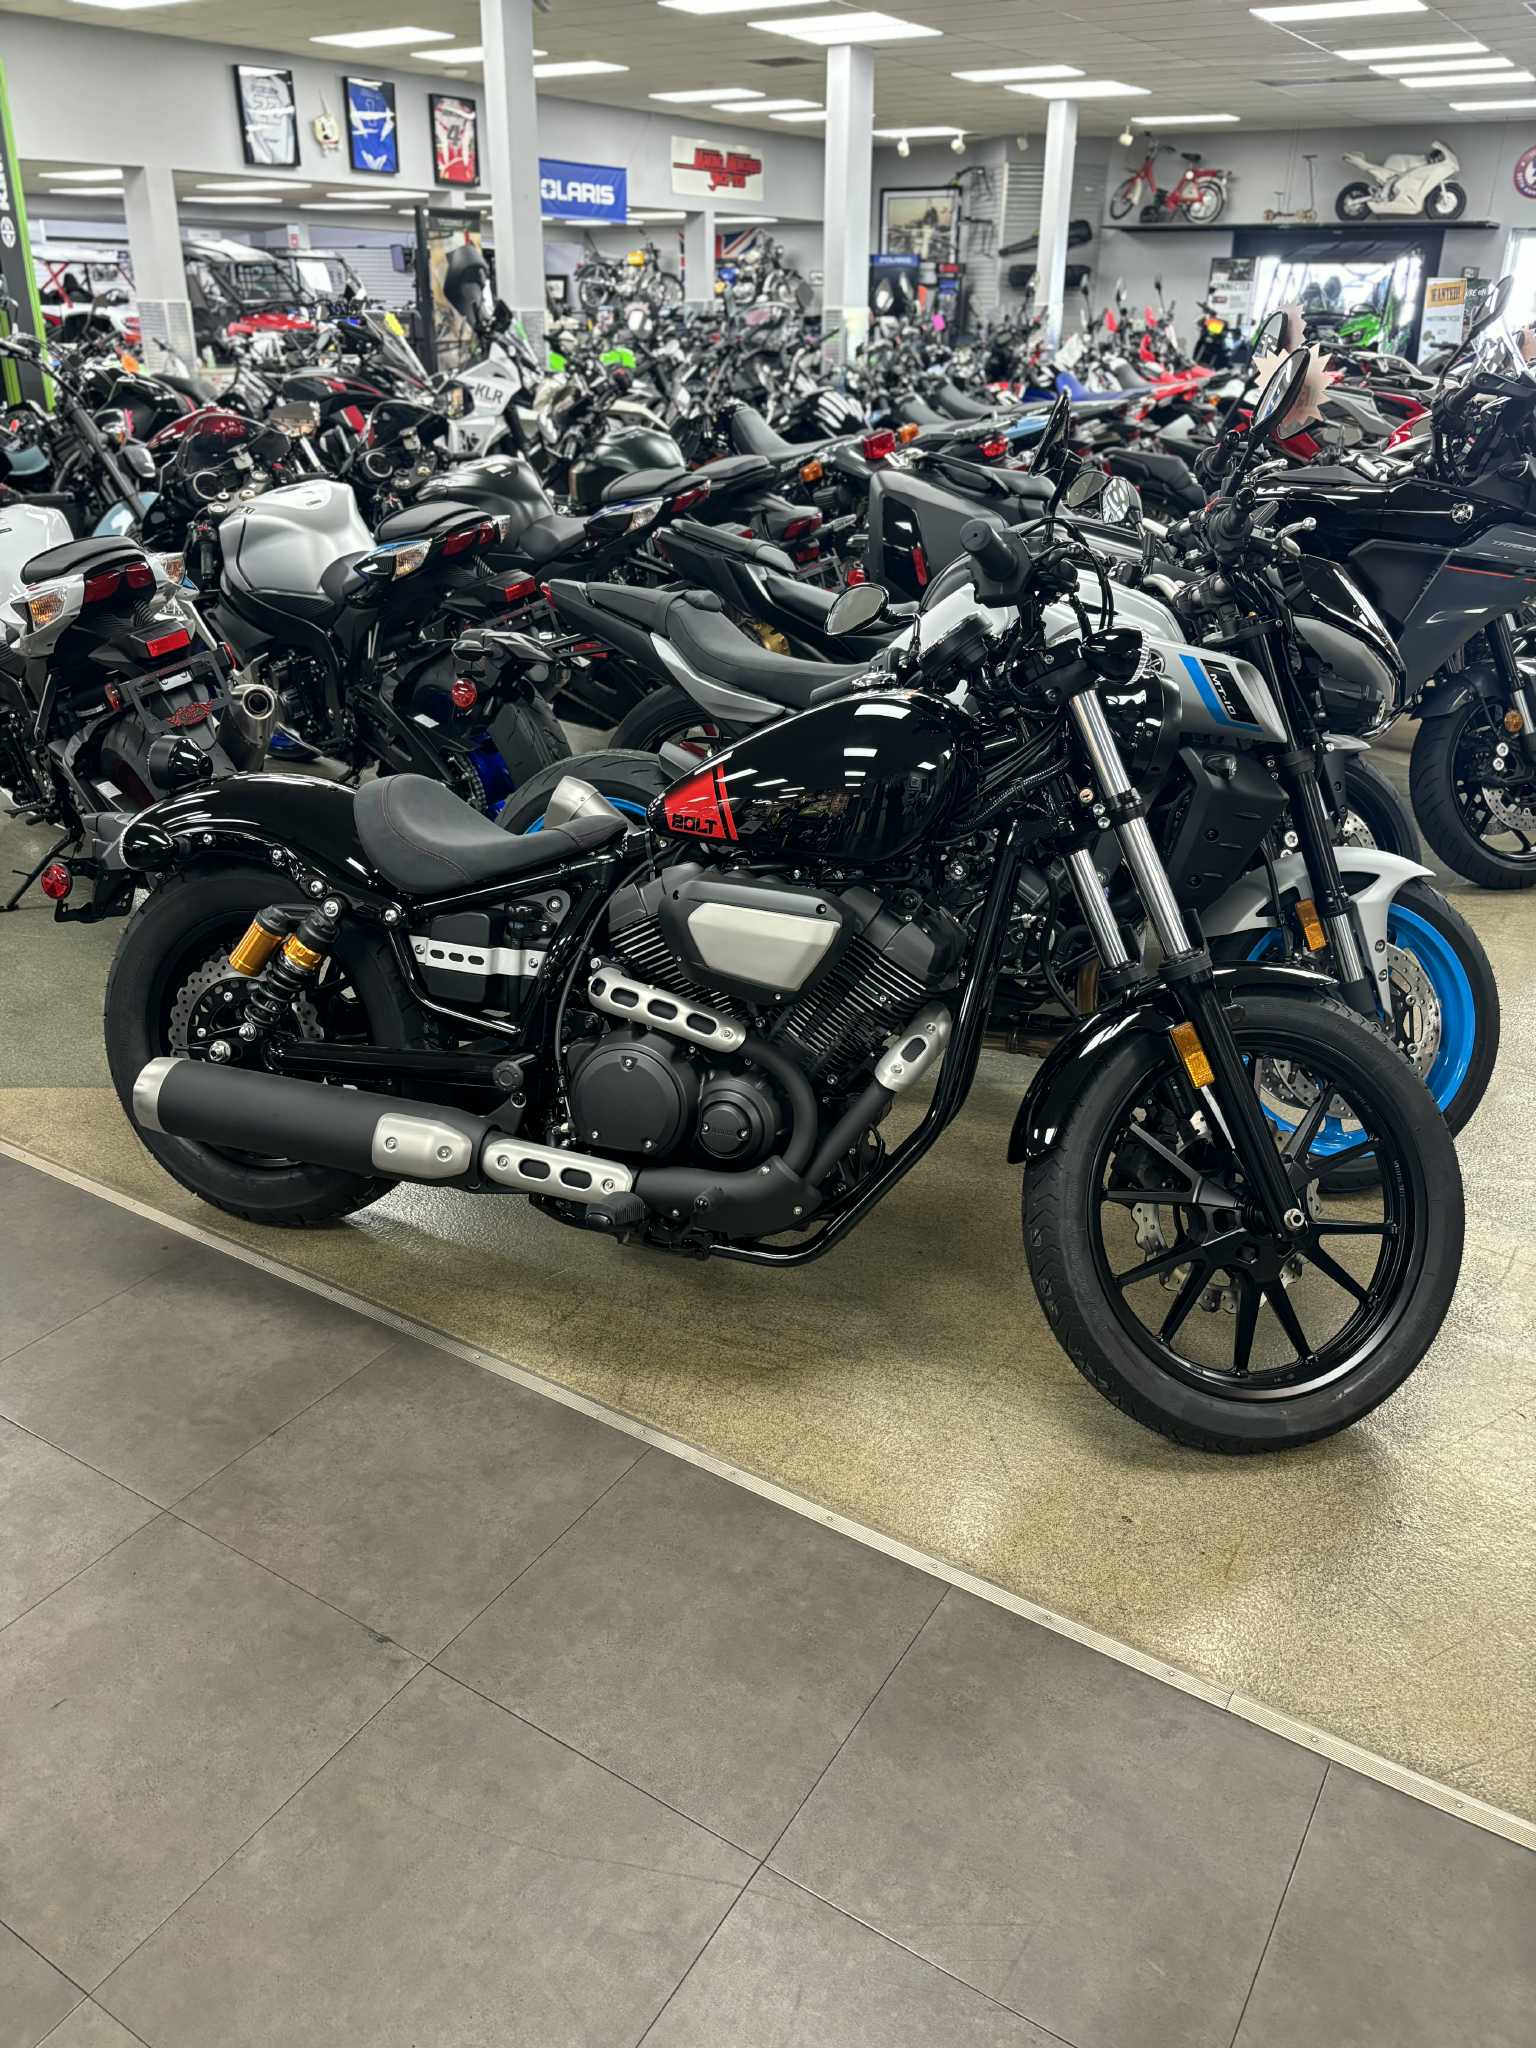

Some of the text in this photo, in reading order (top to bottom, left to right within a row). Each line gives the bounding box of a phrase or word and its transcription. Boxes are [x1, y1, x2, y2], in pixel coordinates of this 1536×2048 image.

[447, 124, 461, 145] 4
[540, 178, 615, 206] OLARIS
[475, 383, 503, 404] KLR
[1209, 673, 1237, 715] MT-10
[672, 813, 717, 834] BOLT
